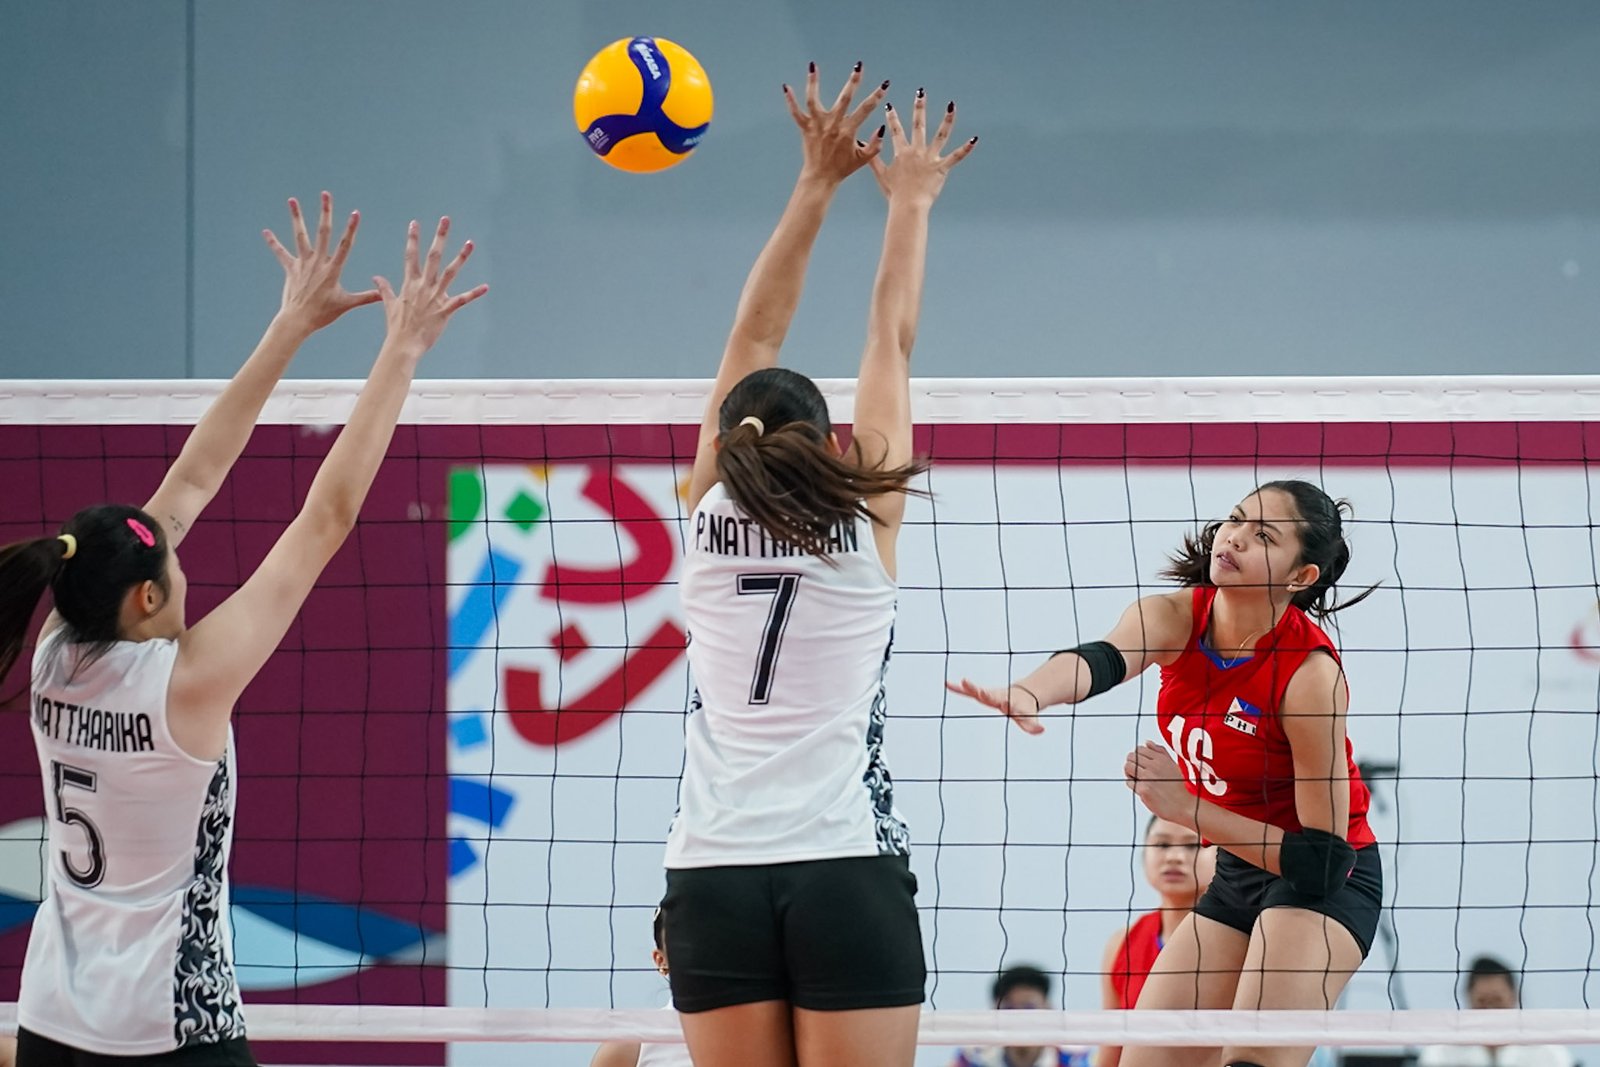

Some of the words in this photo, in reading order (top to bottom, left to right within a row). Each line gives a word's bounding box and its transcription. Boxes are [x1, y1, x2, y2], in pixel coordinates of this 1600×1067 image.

[736, 573, 801, 705] 7
[1167, 714, 1228, 797] 16
[51, 760, 106, 889] 5
